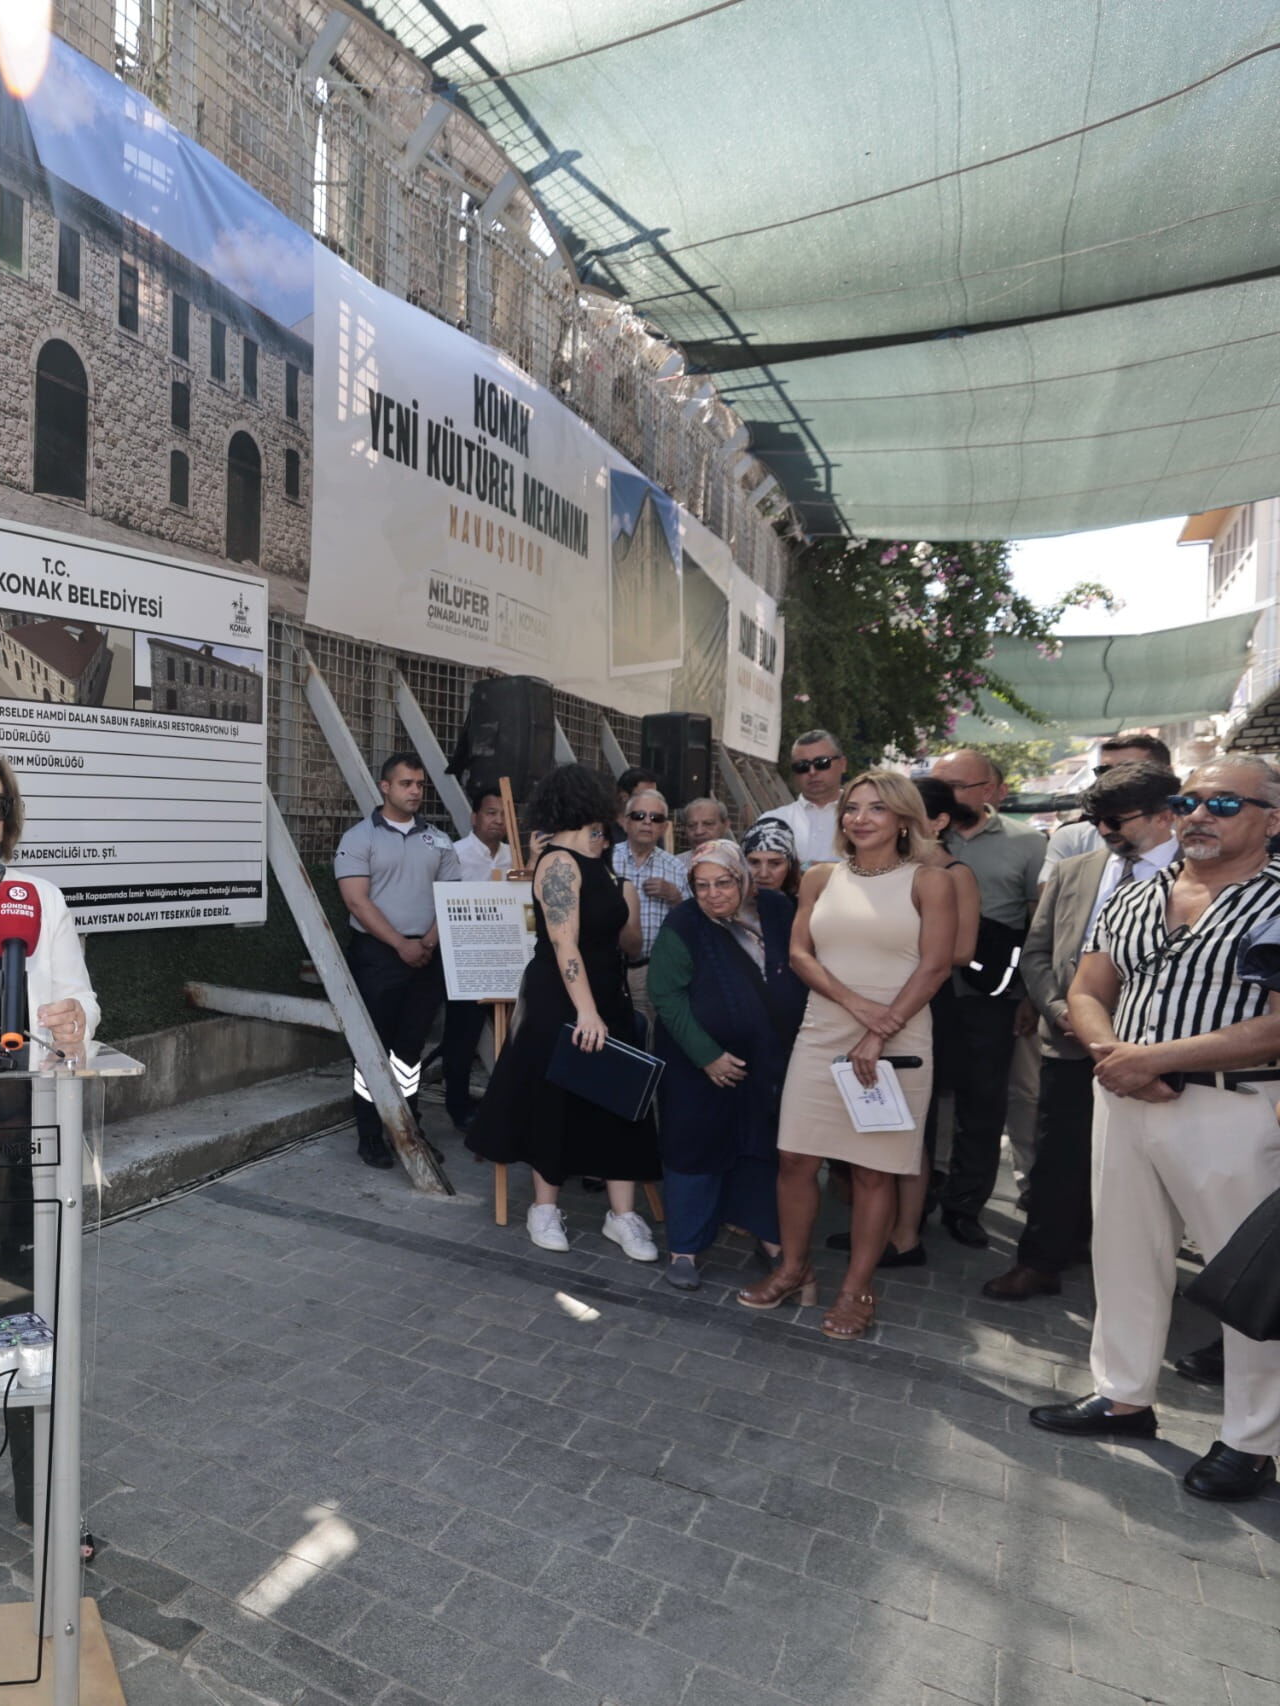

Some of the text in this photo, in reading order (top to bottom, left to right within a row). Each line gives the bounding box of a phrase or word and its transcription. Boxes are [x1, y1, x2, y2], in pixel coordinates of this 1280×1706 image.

[474, 373, 530, 458] KONAK
[367, 387, 588, 559] YENİ KÜLTÜREL MEKANINA
[449, 504, 543, 576] KAVUŞUYOR
[42, 557, 70, 578] T.C.
[68, 583, 163, 618] BELEDİYESİ
[427, 604, 489, 632] ÇINARLI MUTLU
[36, 709, 67, 721] HAMDİ
[68, 712, 98, 724] DALAN
[100, 714, 129, 726] SABUN
[130, 717, 170, 730] FABRİKASI
[171, 722, 229, 736] RESTORASYONU
[26, 754, 84, 769] MÜDÜRLÜĞÜ
[21, 846, 81, 859] MADENCİLİĞİ
[83, 848, 100, 858] LTD.
[11, 888, 26, 897] 35
[0, 909, 34, 917] OTUZBEŞ
[1, 903, 34, 911] GÜNDEM
[127, 911, 158, 922] DOLAYI
